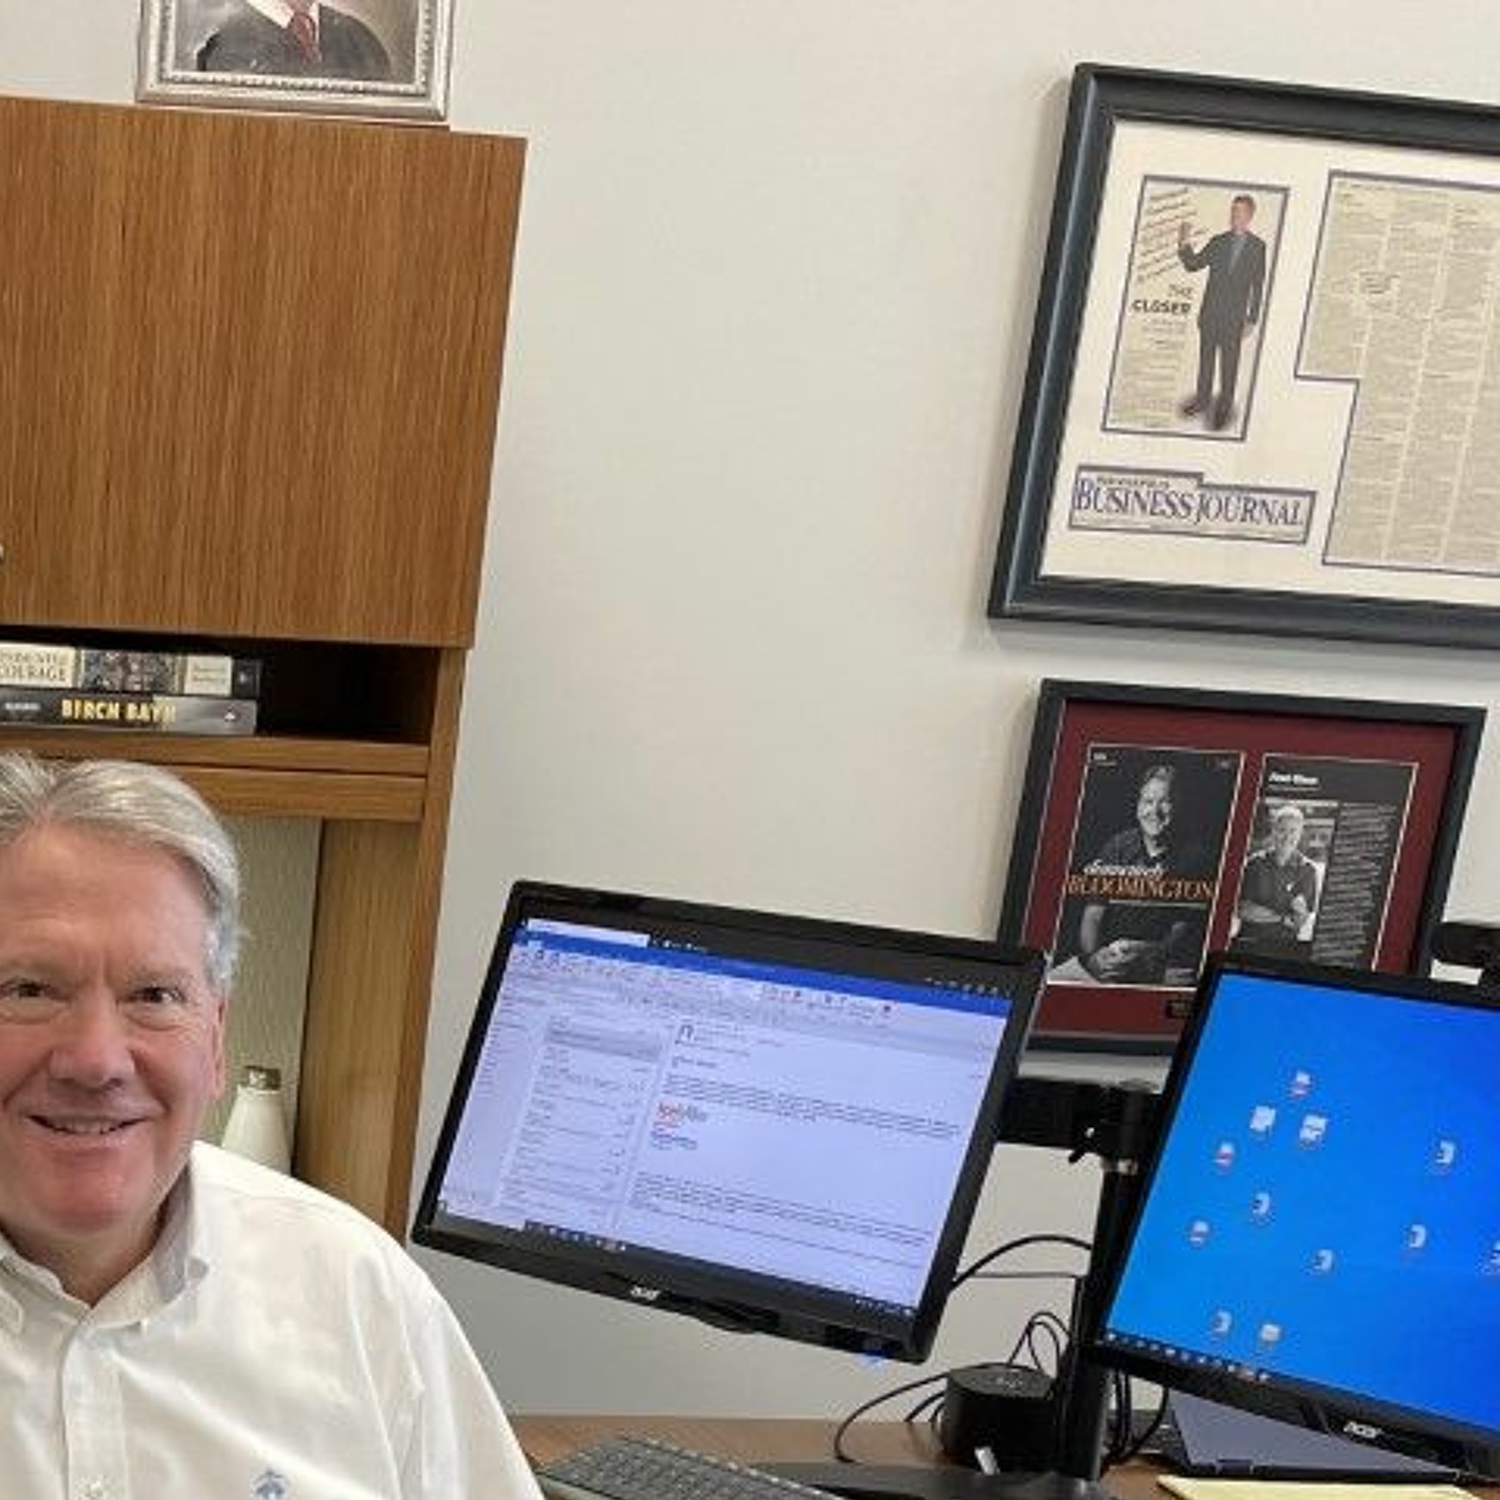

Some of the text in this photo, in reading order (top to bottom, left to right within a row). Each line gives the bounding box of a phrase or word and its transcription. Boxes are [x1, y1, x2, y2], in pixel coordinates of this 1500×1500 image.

[1075, 478, 1301, 525] BUSINESS JOURNAL
[61, 699, 120, 721] BIRCH
